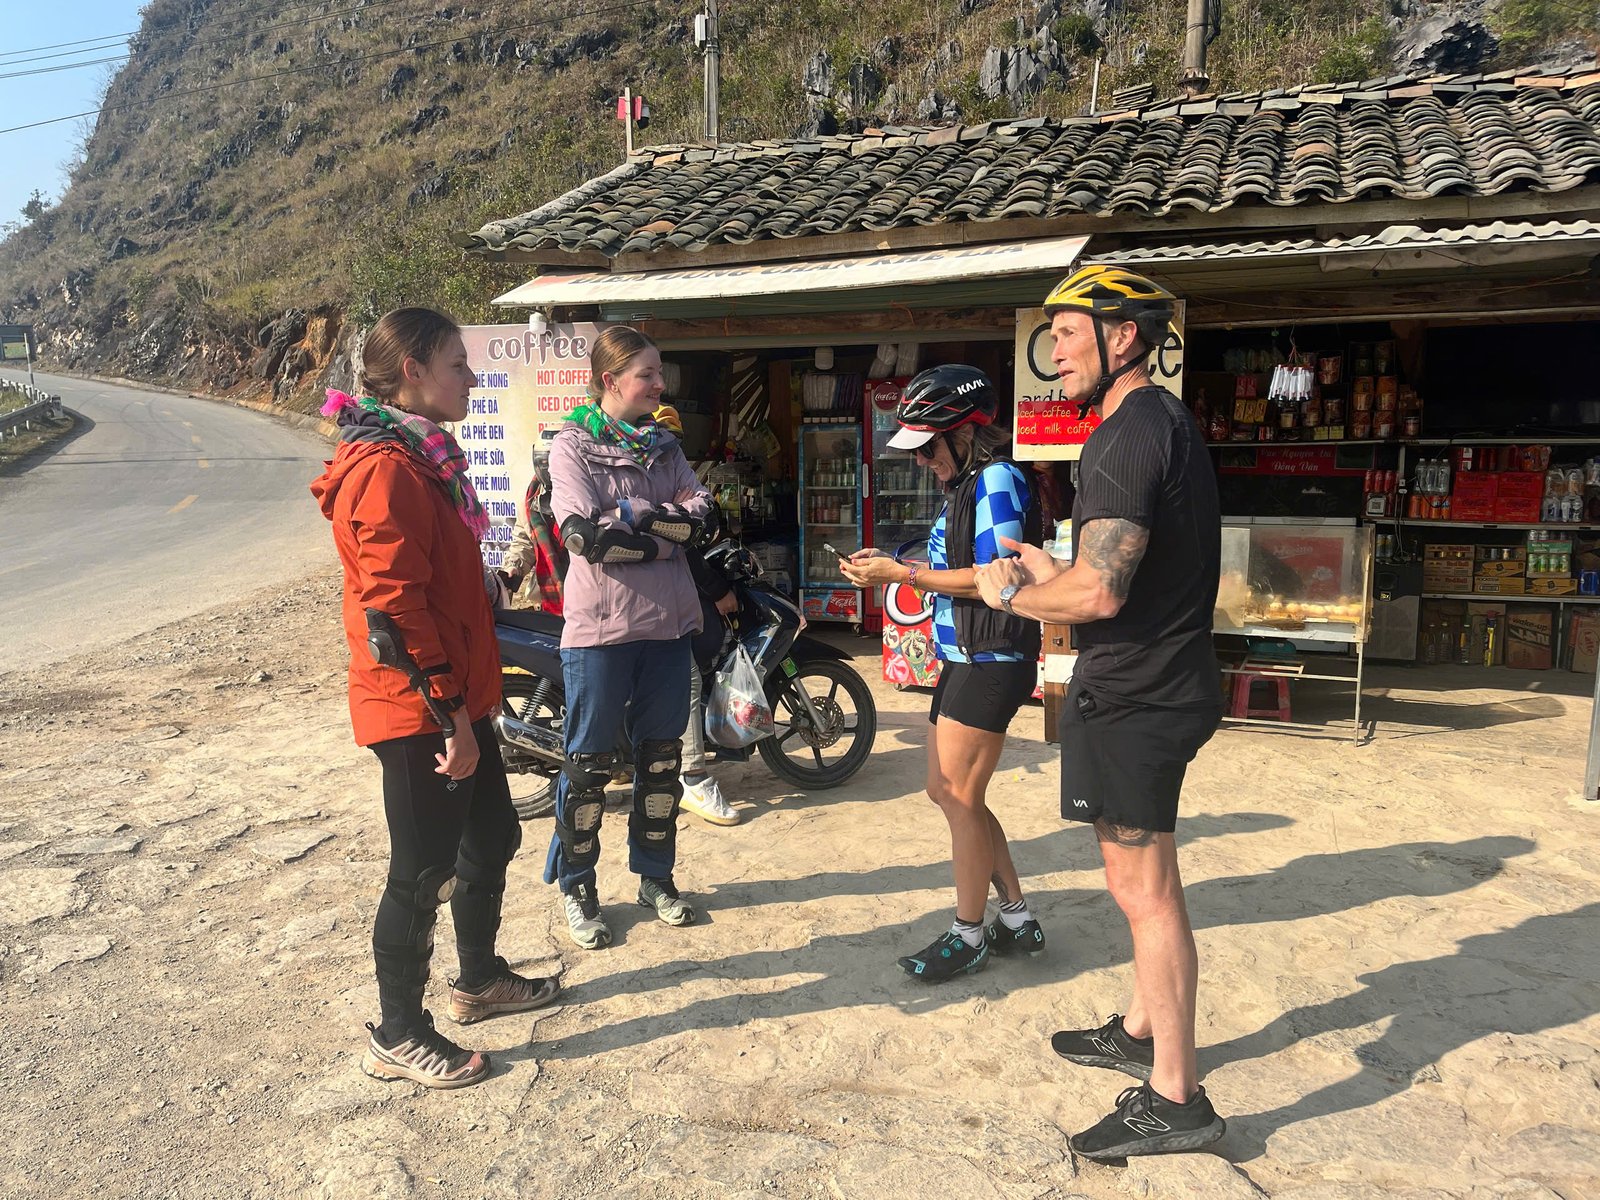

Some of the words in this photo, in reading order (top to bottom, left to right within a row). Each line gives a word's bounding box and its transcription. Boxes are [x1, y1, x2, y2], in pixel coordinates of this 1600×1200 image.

[487, 331, 588, 366] coffee
[476, 370, 486, 388] HÊ
[488, 370, 509, 388] NÓNG
[537, 370, 555, 385] HOT
[472, 396, 486, 414] PHÊ
[488, 396, 499, 414] ĐÁ
[538, 396, 560, 411] ICED
[461, 423, 472, 440] CÀ
[473, 422, 487, 440] PHÊ
[489, 425, 504, 440] ĐEN
[1044, 422, 1062, 435] milk
[1066, 421, 1096, 435] coffe
[474, 448, 488, 465] PHÊ
[475, 473, 489, 491] PHÊ
[491, 471, 510, 491] MUỐI
[491, 499, 516, 516] TRỨNG
